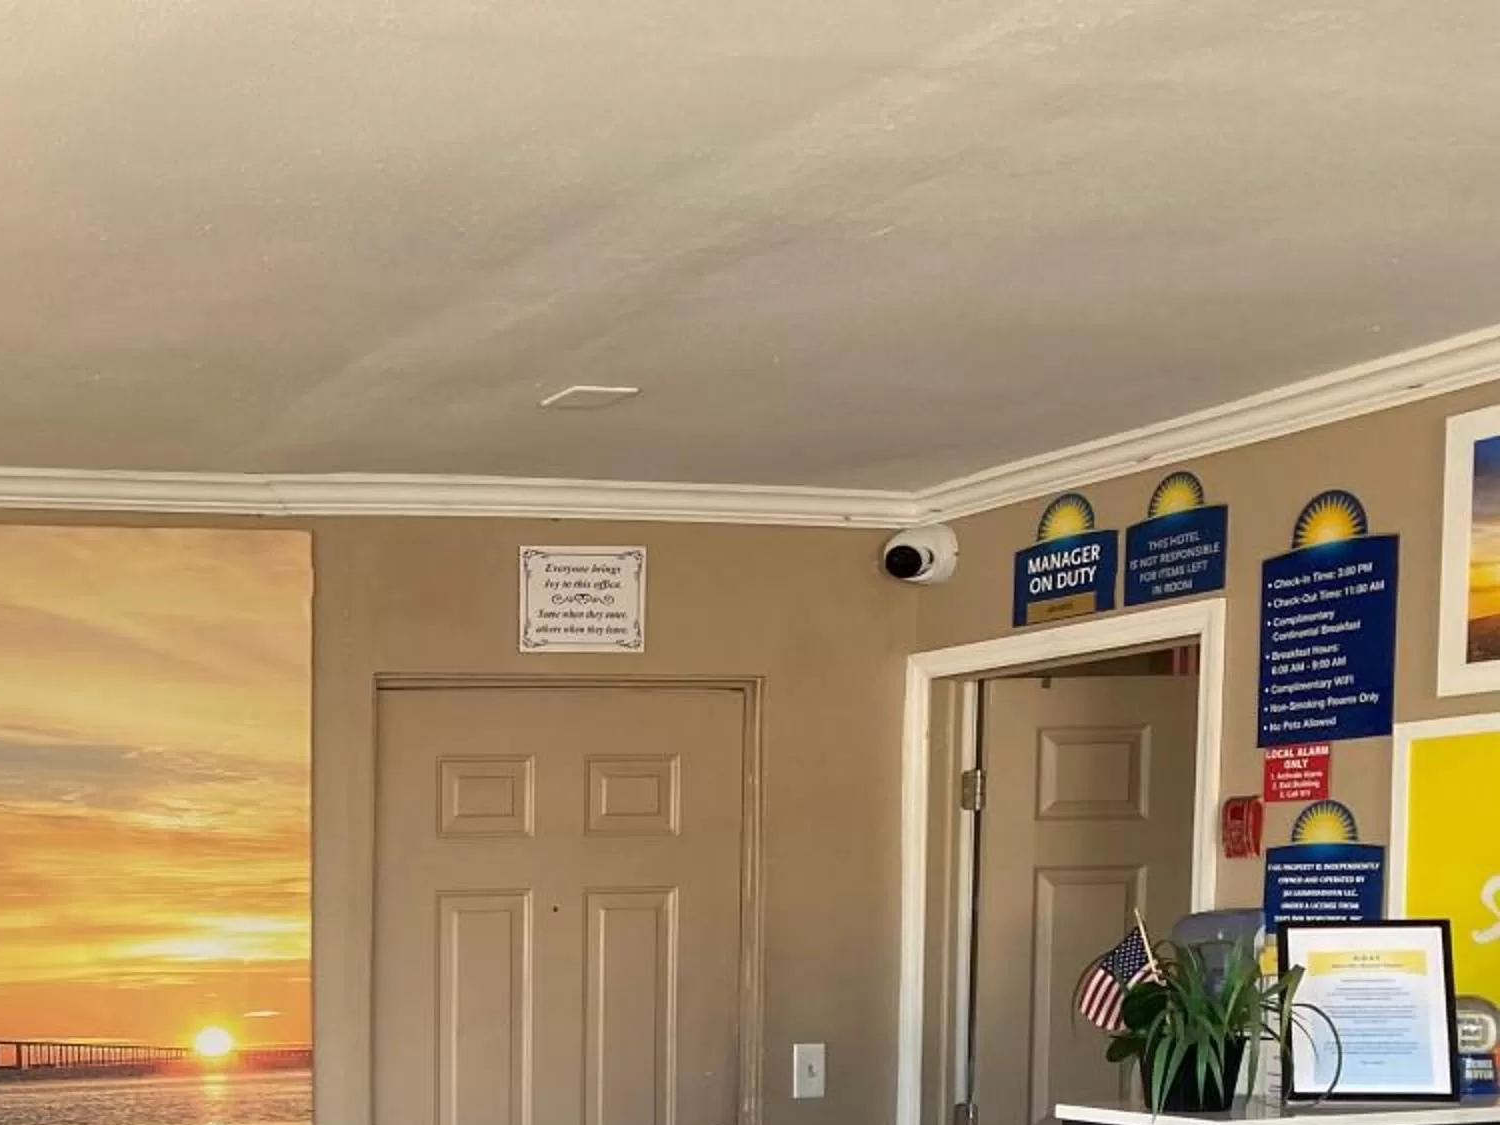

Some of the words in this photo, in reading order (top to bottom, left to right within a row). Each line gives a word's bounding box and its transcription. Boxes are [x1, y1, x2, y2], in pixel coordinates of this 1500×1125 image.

[1028, 544, 1100, 574] MANAGER
[1140, 555, 1157, 568] NOT
[1160, 543, 1220, 564] RESPONSIBLE
[1029, 576, 1052, 594] ON
[1057, 566, 1096, 589] DUTY
[1266, 749, 1294, 758] LOCAL
[1298, 746, 1329, 756] ALARM
[1284, 759, 1308, 768] ONLY
